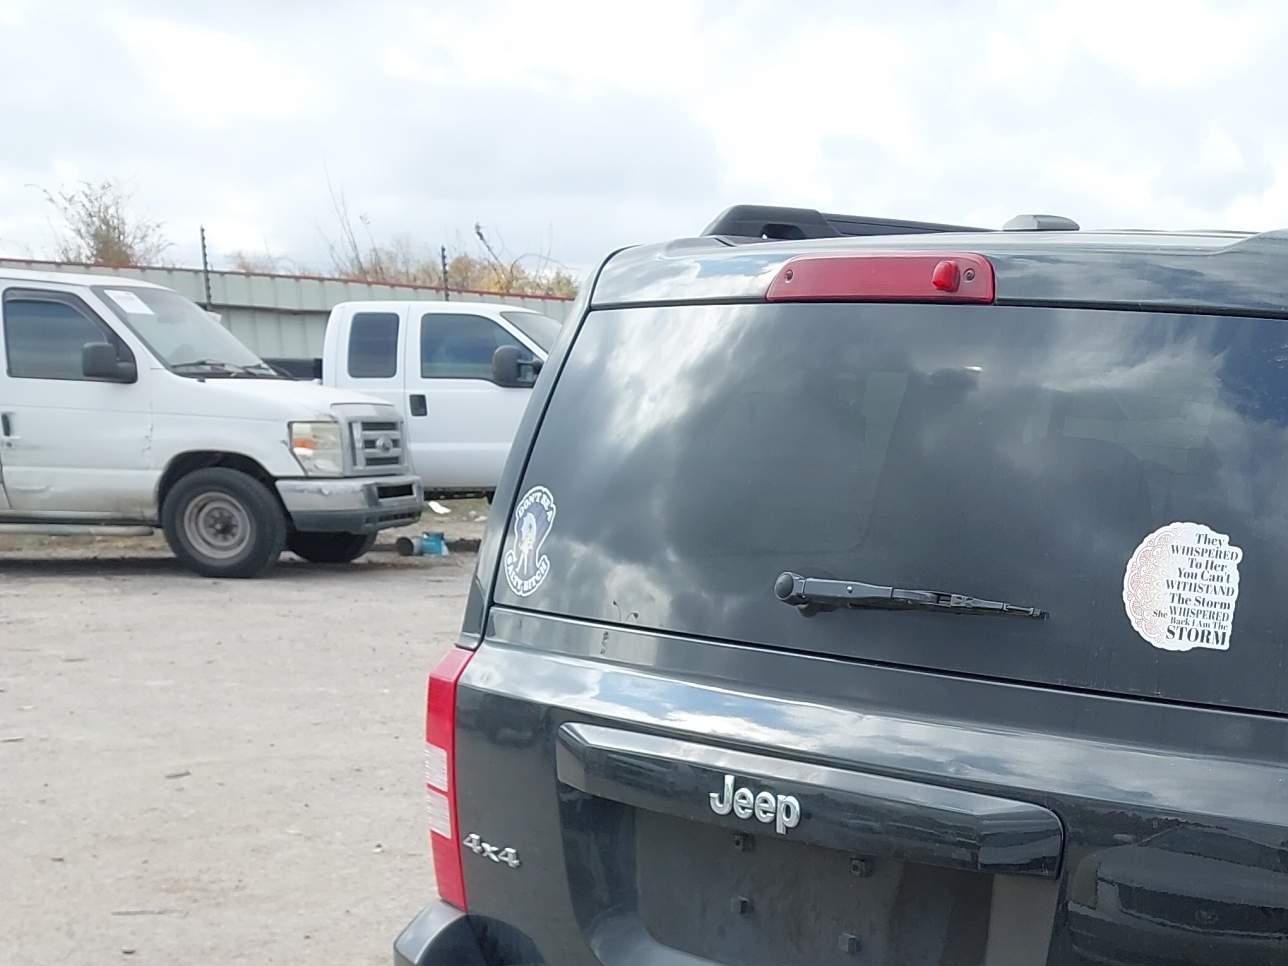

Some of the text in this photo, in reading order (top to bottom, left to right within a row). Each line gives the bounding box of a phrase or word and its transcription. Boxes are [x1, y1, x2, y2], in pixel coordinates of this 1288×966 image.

[1196, 533, 1225, 546] They
[1171, 544, 1238, 561] WHISPERED
[1188, 557, 1202, 569] To
[523, 560, 547, 589] BITCH
[1178, 567, 1230, 583] You Can't
[1166, 579, 1234, 597] WITHSTAND
[1170, 592, 1230, 610] The Storm
[1152, 606, 1229, 622] She WHISPERED
[1170, 616, 1190, 625] Back
[1198, 620, 1210, 628] Am
[1213, 621, 1228, 631] The
[1166, 625, 1226, 645] STORM
[709, 775, 801, 834] Jeep
[463, 833, 520, 868] 4x4
